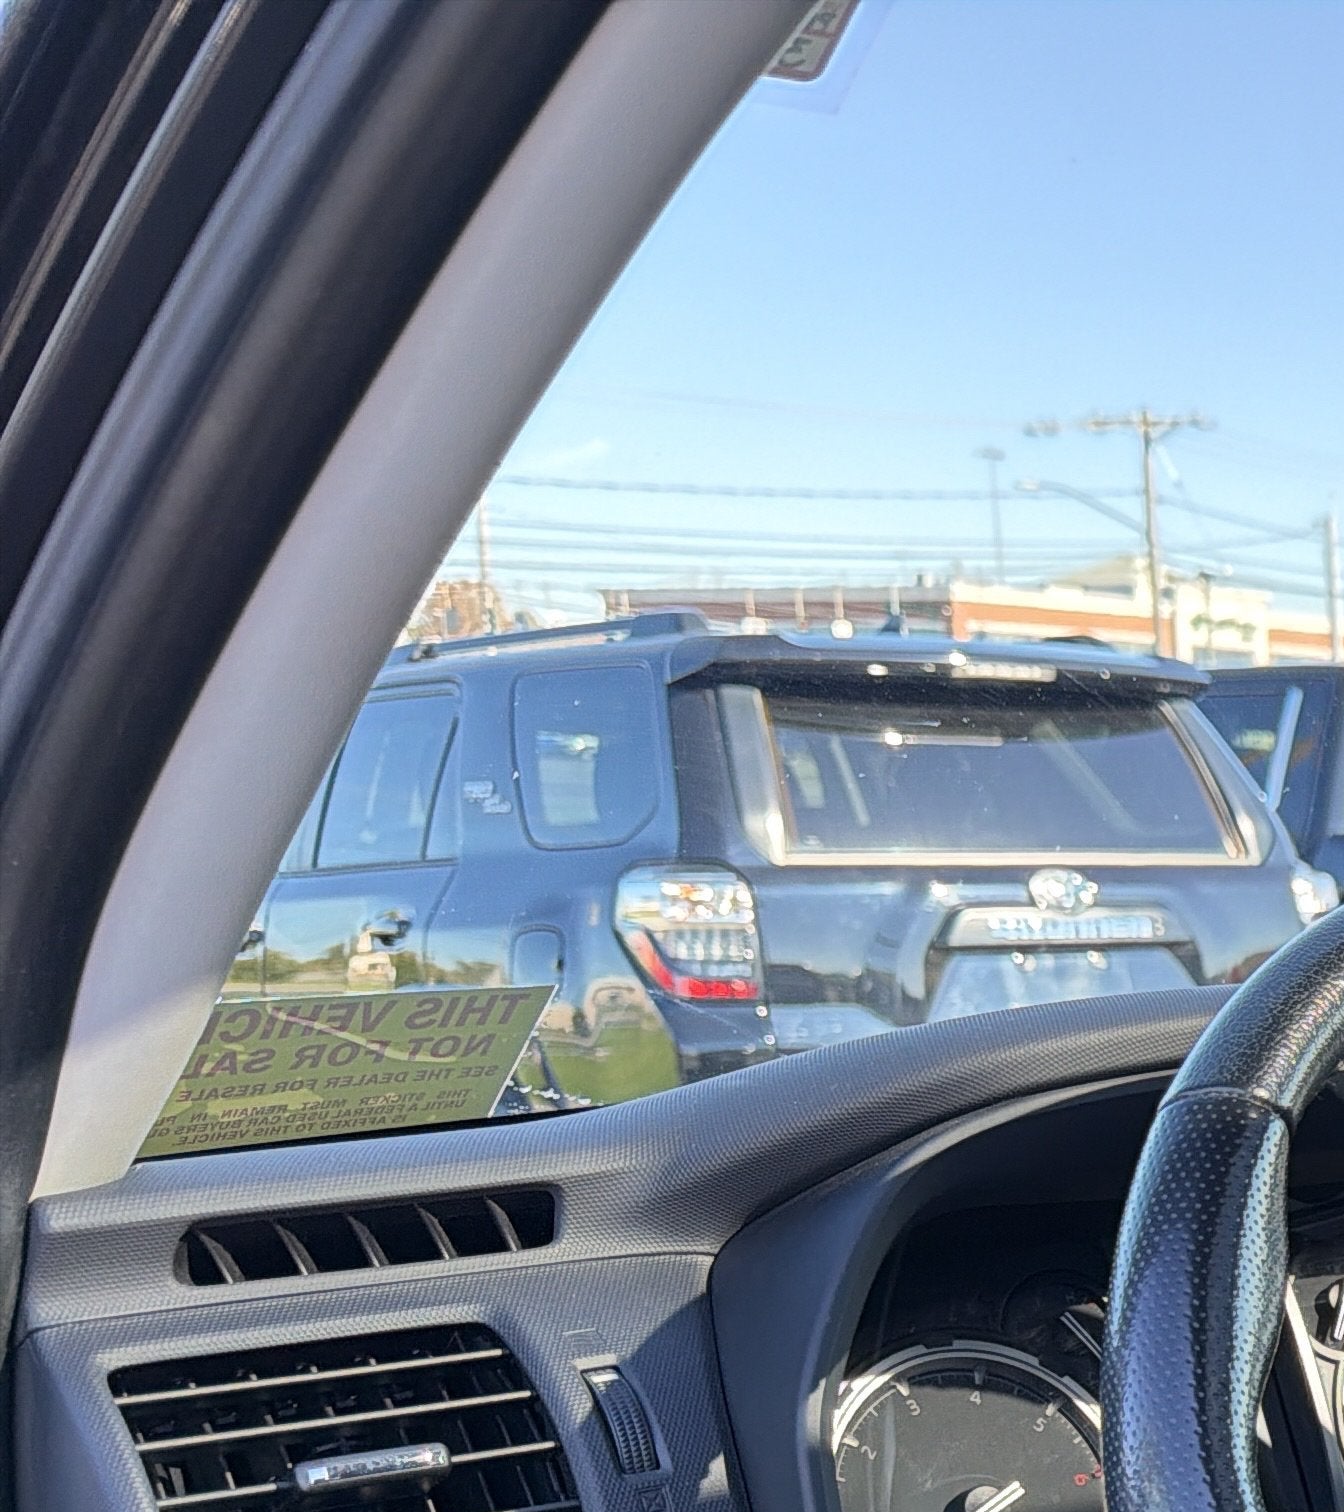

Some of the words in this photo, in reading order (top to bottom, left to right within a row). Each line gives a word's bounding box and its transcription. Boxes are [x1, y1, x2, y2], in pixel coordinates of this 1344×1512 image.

[969, 1391, 982, 1406] 4
[907, 1400, 921, 1416] 3
[1033, 1417, 1047, 1433] 5
[861, 1445, 878, 1460] 2
